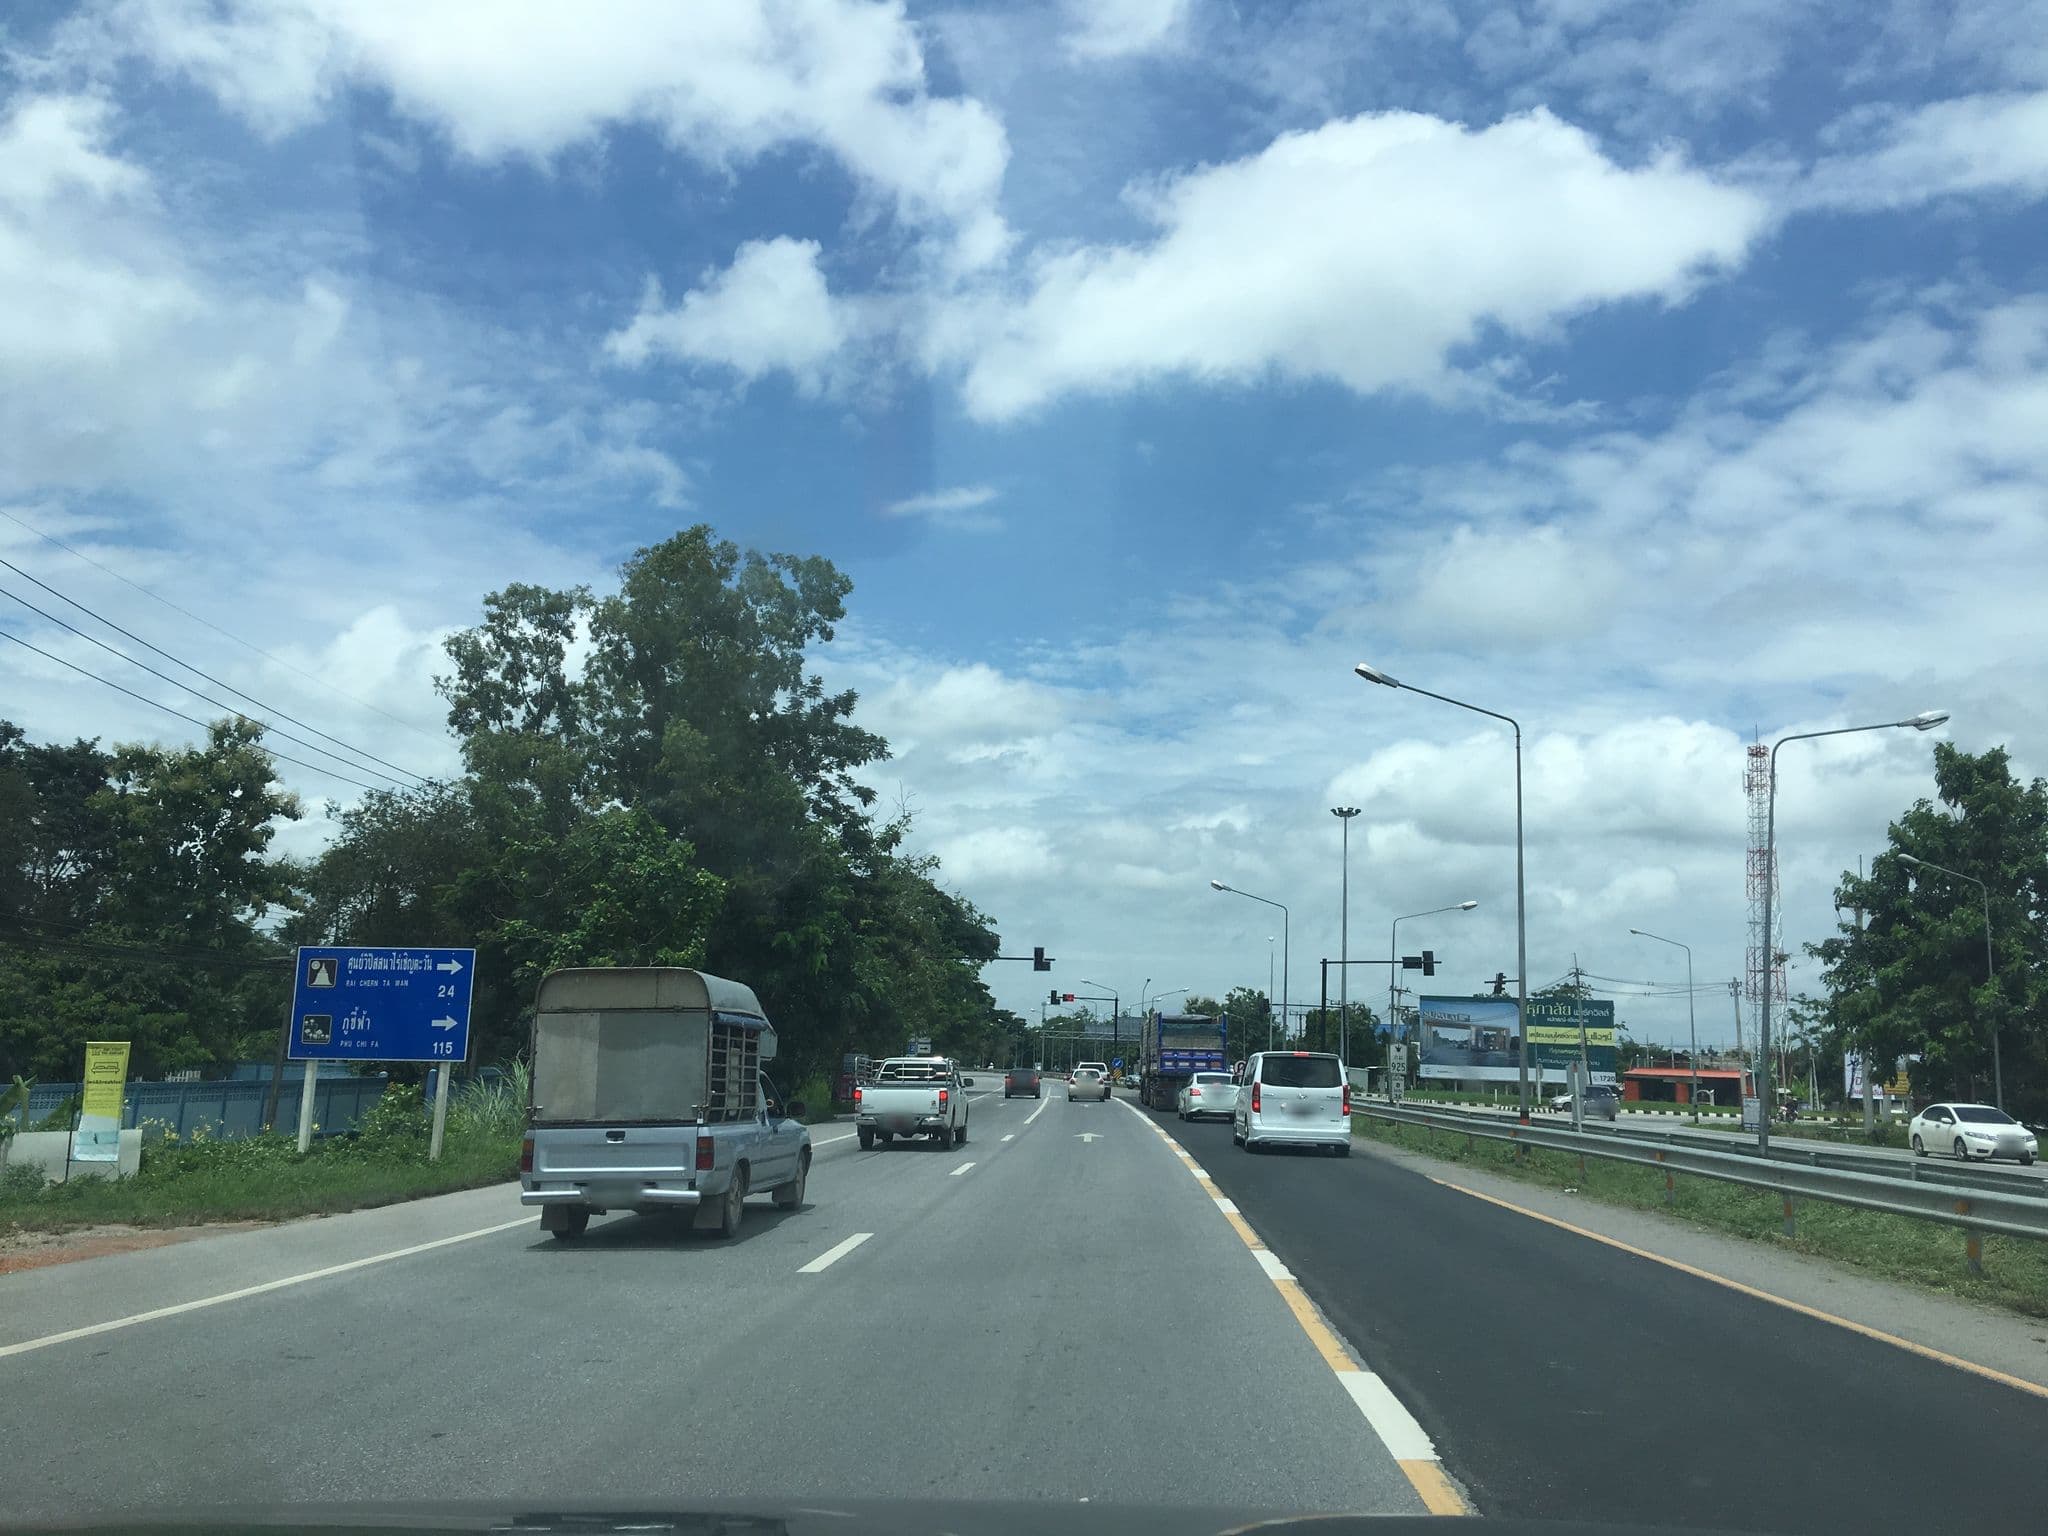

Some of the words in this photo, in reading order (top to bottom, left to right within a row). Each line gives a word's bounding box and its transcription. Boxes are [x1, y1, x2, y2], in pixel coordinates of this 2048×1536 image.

[383, 979, 391, 987] TA
[437, 985, 455, 998] 24
[356, 1040, 368, 1048] CHI
[432, 1041, 453, 1055] 115
[1391, 1062, 1406, 1072] 925
